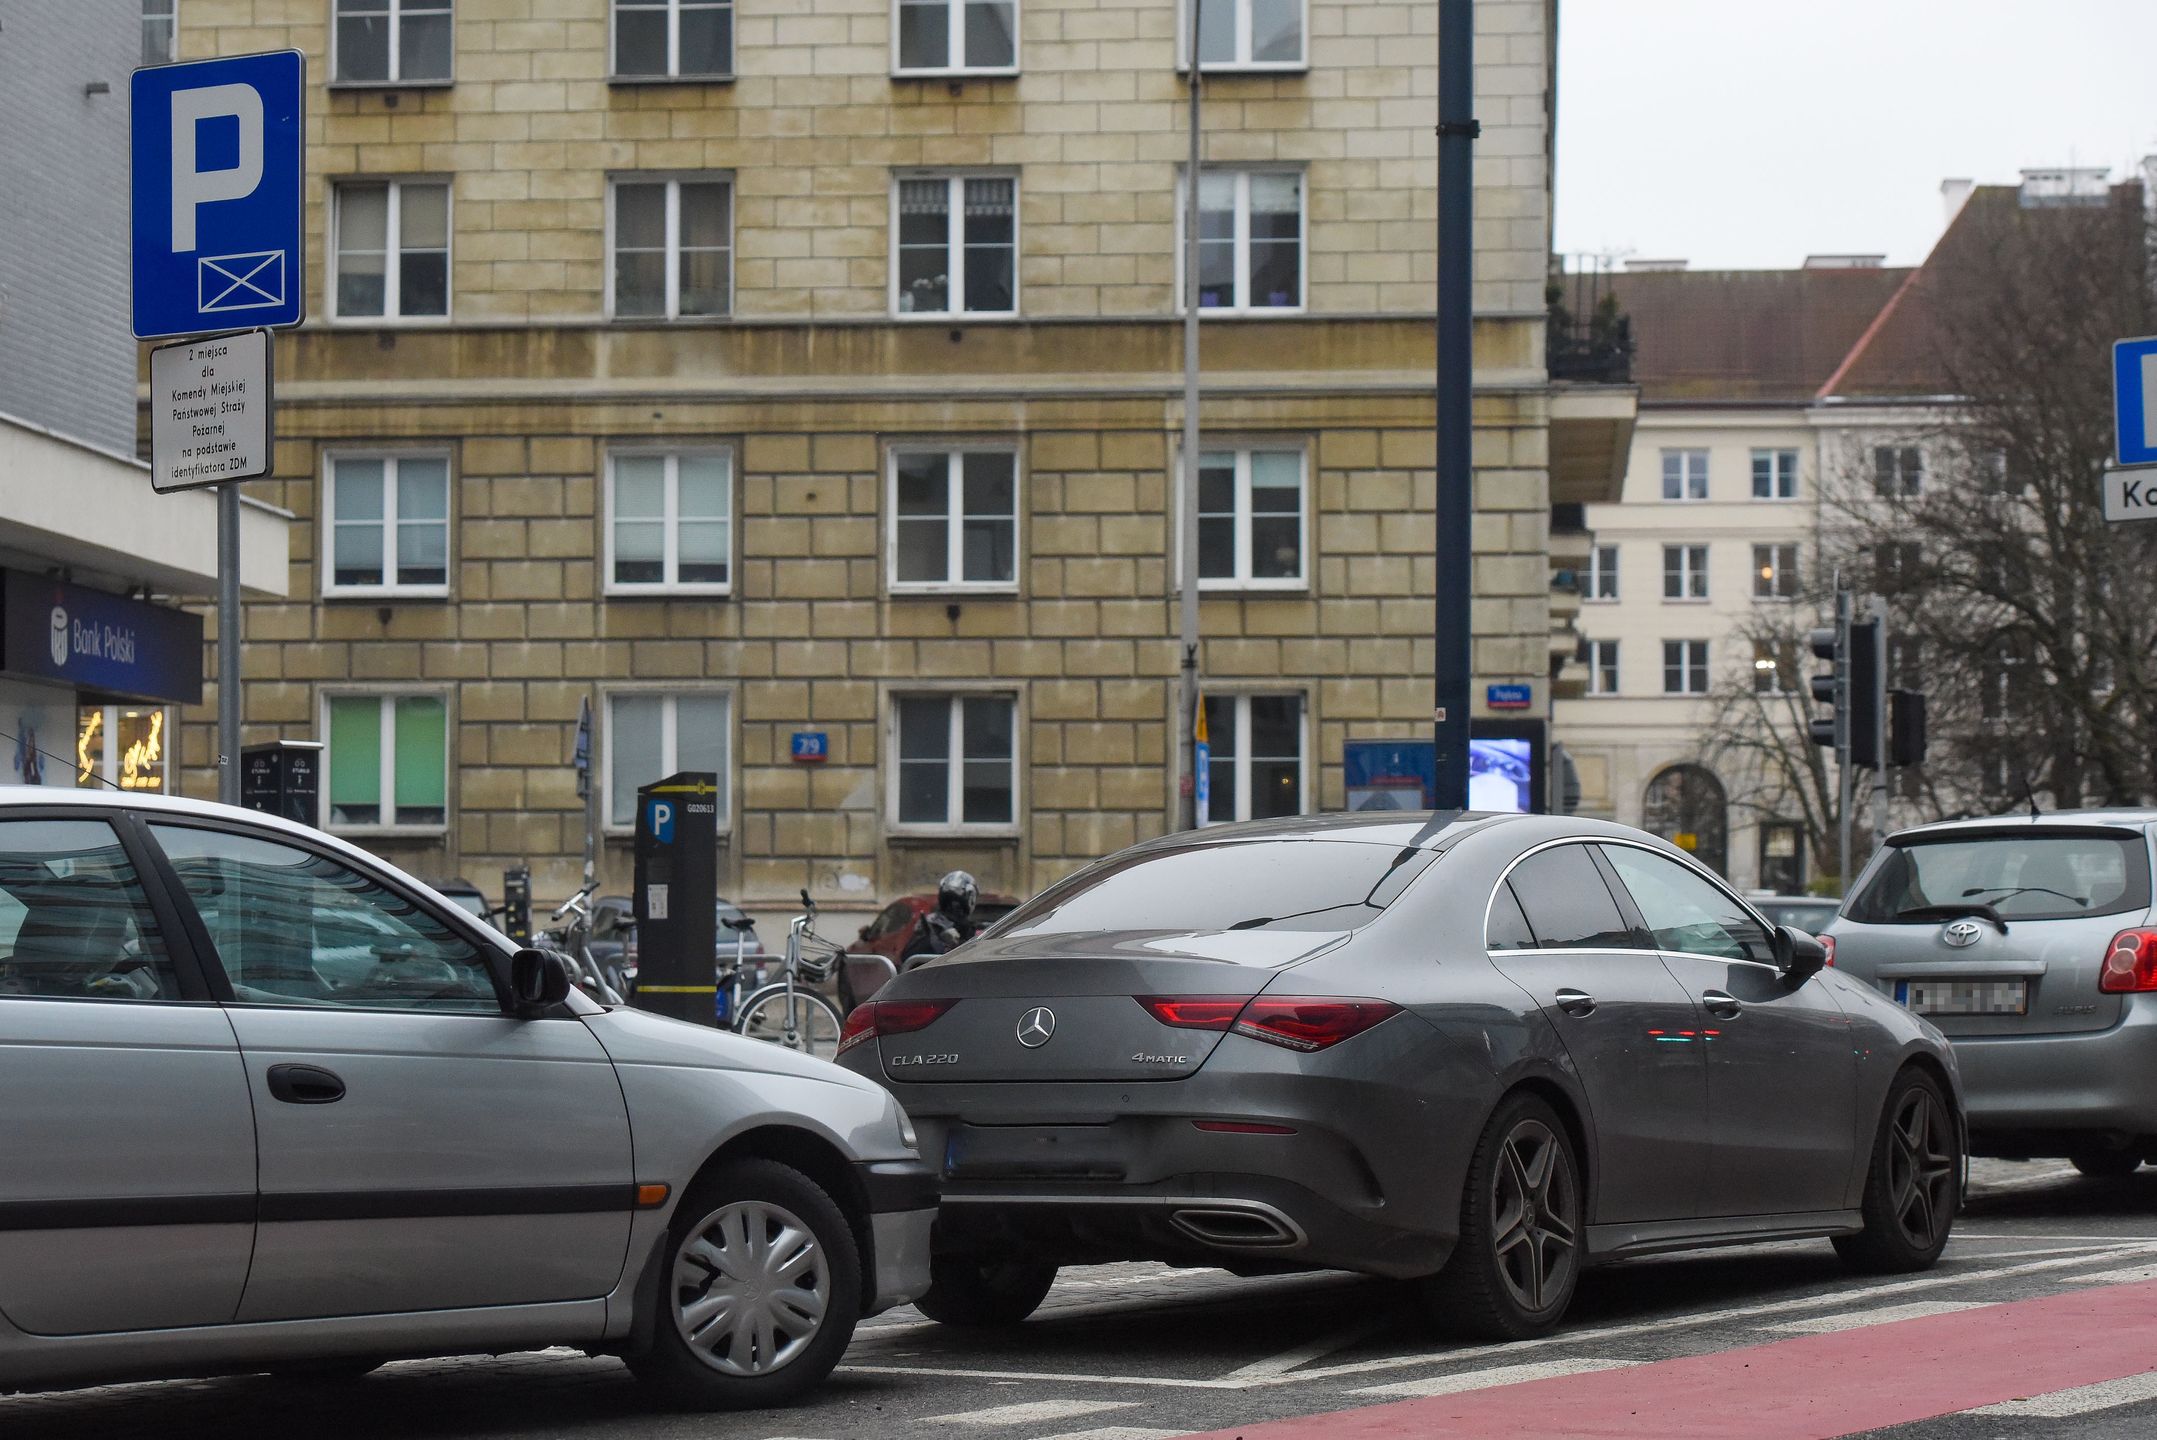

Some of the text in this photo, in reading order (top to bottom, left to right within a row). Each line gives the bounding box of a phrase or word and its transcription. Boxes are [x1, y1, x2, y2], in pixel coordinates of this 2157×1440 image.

[171, 83, 264, 253] P
[189, 345, 228, 361] 2 miejsca
[201, 366, 215, 378] dla
[171, 379, 246, 402] Komendy Miejskiej
[172, 400, 246, 421] Państwowej Straży
[192, 421, 225, 437] Pożarnej
[182, 440, 236, 459] na podstawie
[171, 456, 247, 479] identyfikatora ZDM
[74, 618, 101, 656] Bank
[104, 625, 135, 663] Polski
[655, 804, 670, 836] P
[892, 1053, 959, 1066] CLA 220
[1131, 1052, 1187, 1063] 4MATIC
